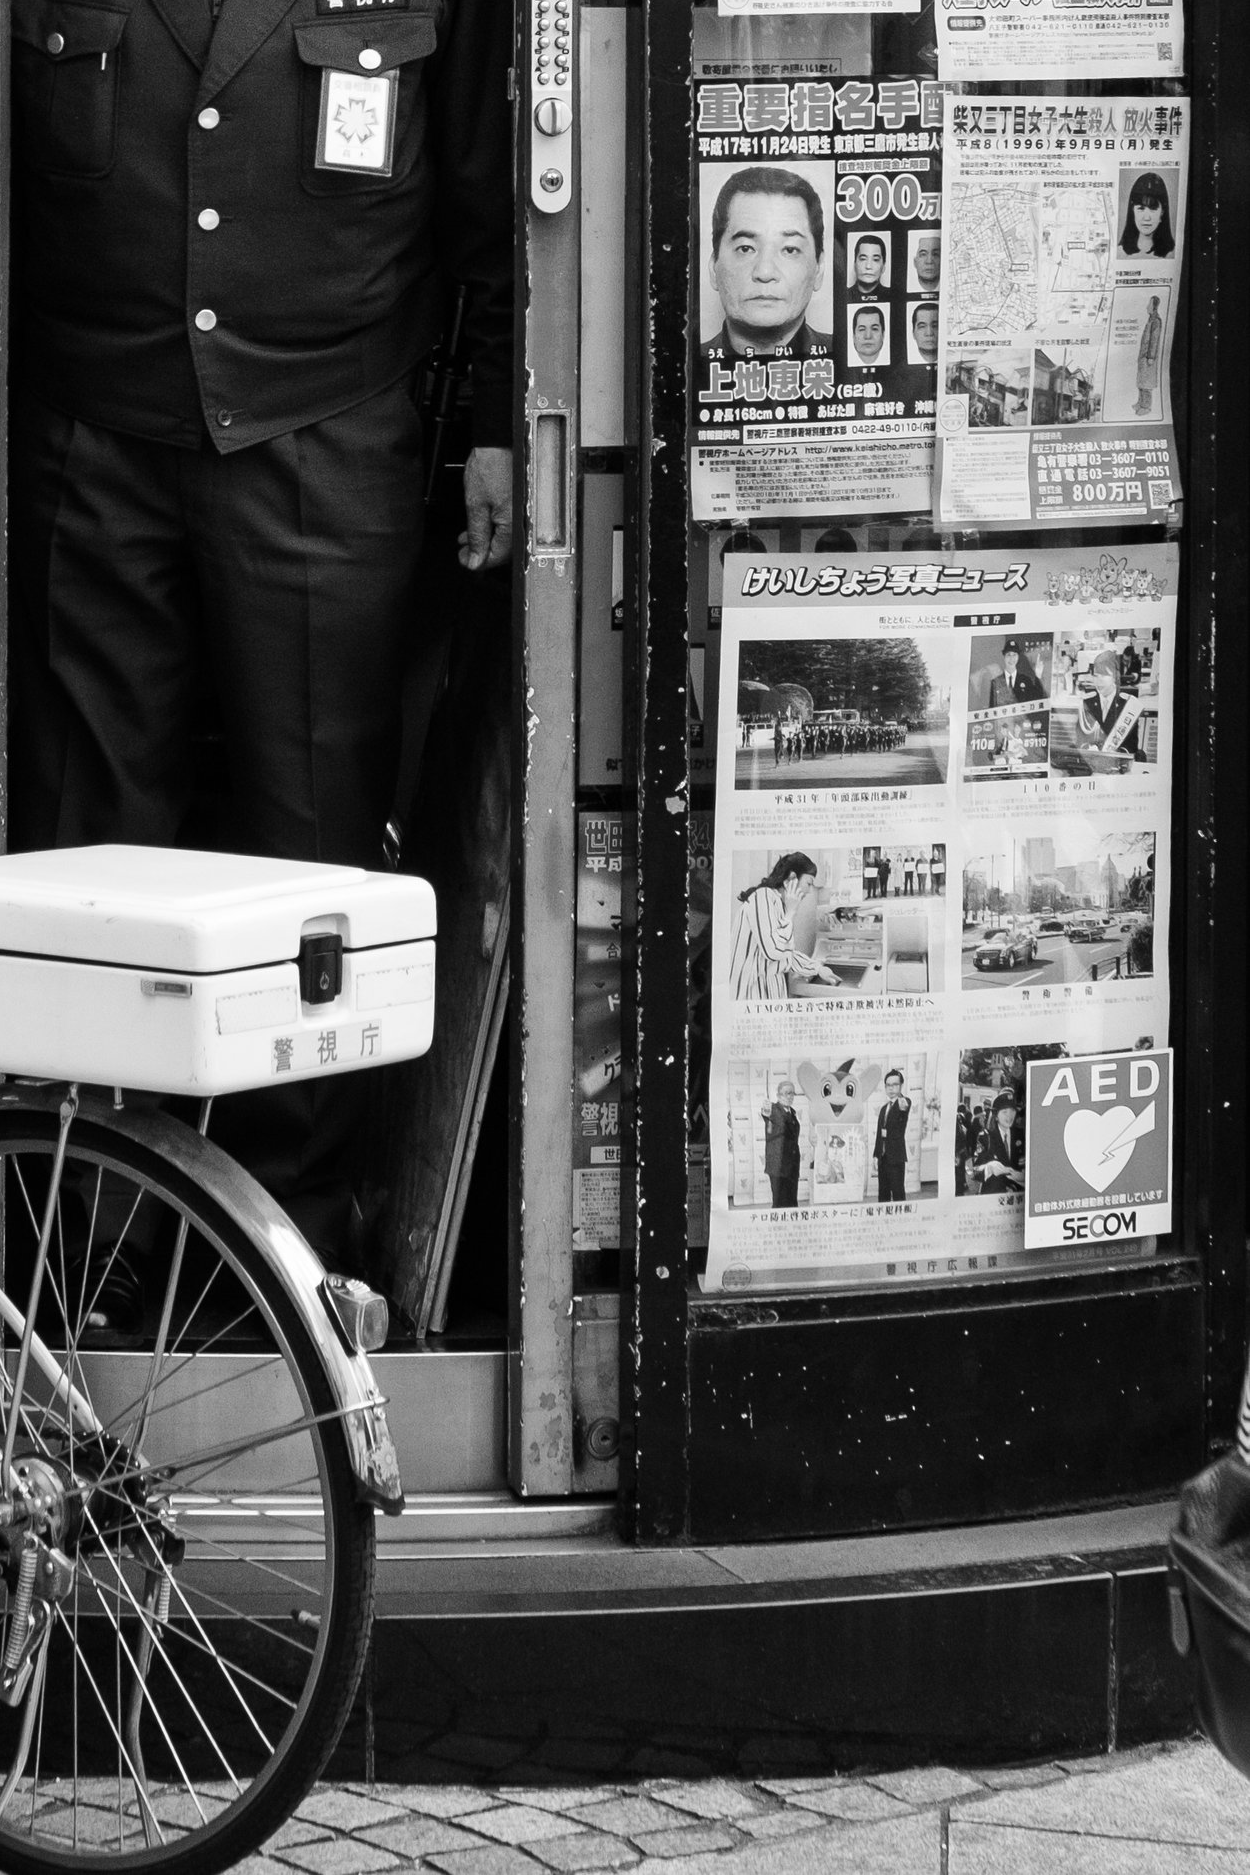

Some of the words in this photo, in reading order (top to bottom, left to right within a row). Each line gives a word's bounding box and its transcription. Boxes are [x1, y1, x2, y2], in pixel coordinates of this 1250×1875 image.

[953, 104, 1118, 136] 柴又三丁目女子大生殺人
[1123, 105, 1183, 137] 放火事件
[698, 136, 832, 156] 平成17年11月24日発生
[834, 133, 943, 155] 東京都三鷹市発生殺人
[956, 138, 1174, 152] 平成8(1996)年9月9日(月)発生
[698, 359, 835, 403] 上地恵栄
[837, 382, 884, 400] (62歳)
[713, 406, 773, 422] 身長168cm
[788, 405, 809, 420] 特徴
[864, 401, 906, 416] 麻雀好き
[1037, 454, 1088, 469] 亀有警察署
[1037, 467, 1088, 483] 直通電話
[1072, 481, 1144, 503] 800万円
[741, 562, 1030, 597] けいしちょう写真ニュース
[970, 614, 1003, 625] 警視庁
[1023, 780, 1096, 794] 110番の日
[744, 998, 935, 1015] ATMの光と音で特殊詐欺被害未然防止へ
[274, 1022, 381, 1074] 警視庁
[1041, 1058, 1161, 1107] AED
[750, 1202, 918, 1223] テロ防止啓発ポスターに「鬼平犯科帳」
[1062, 1210, 1138, 1240] SECOM
[886, 1255, 999, 1276] 警視庁広報課
